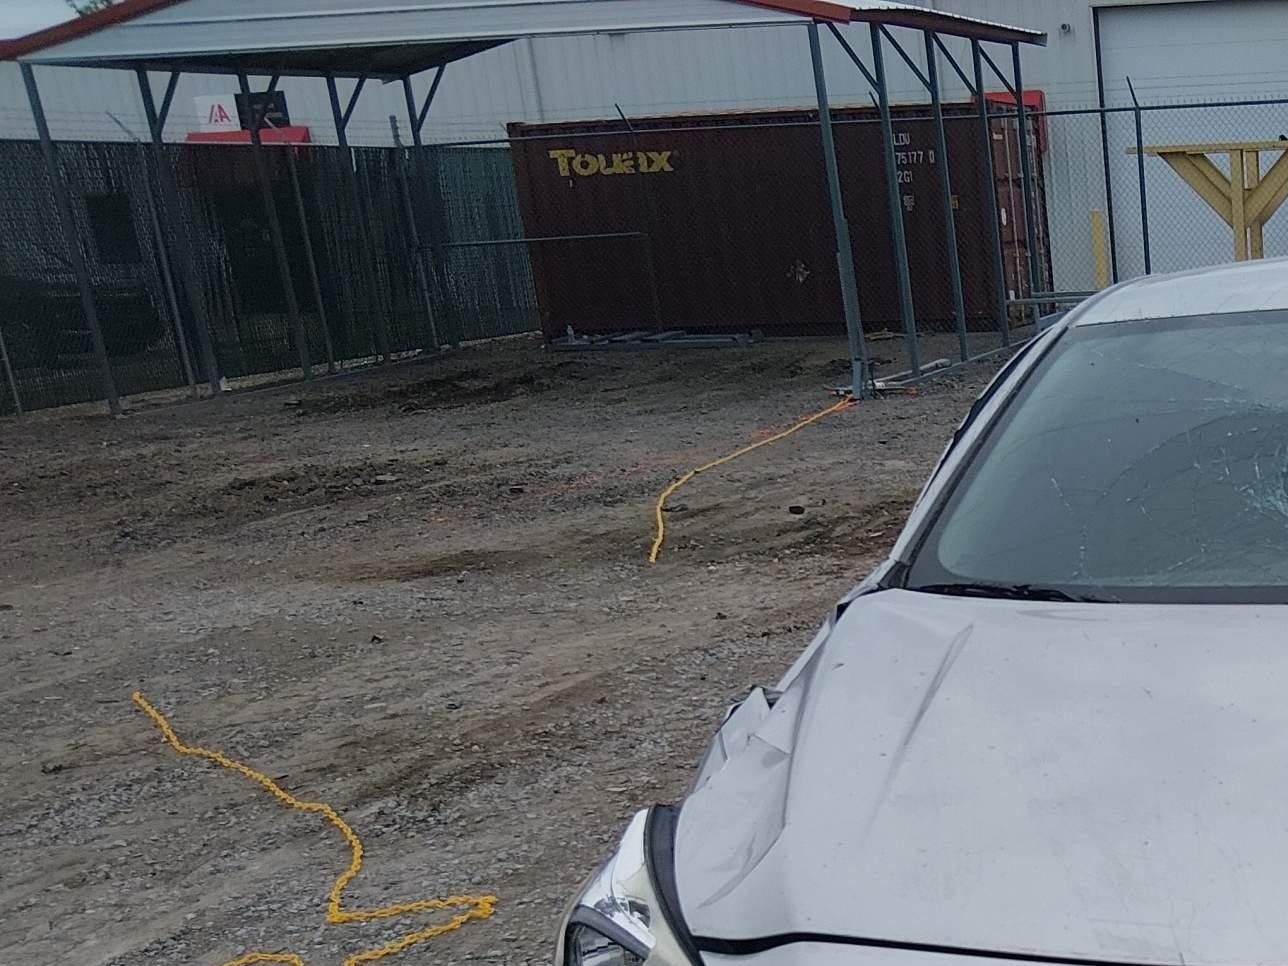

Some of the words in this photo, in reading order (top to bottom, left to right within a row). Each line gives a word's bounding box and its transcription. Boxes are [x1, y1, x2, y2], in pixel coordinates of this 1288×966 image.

[892, 132, 911, 146] LDU
[895, 151, 924, 165] 75177
[896, 170, 913, 184] 2G1
